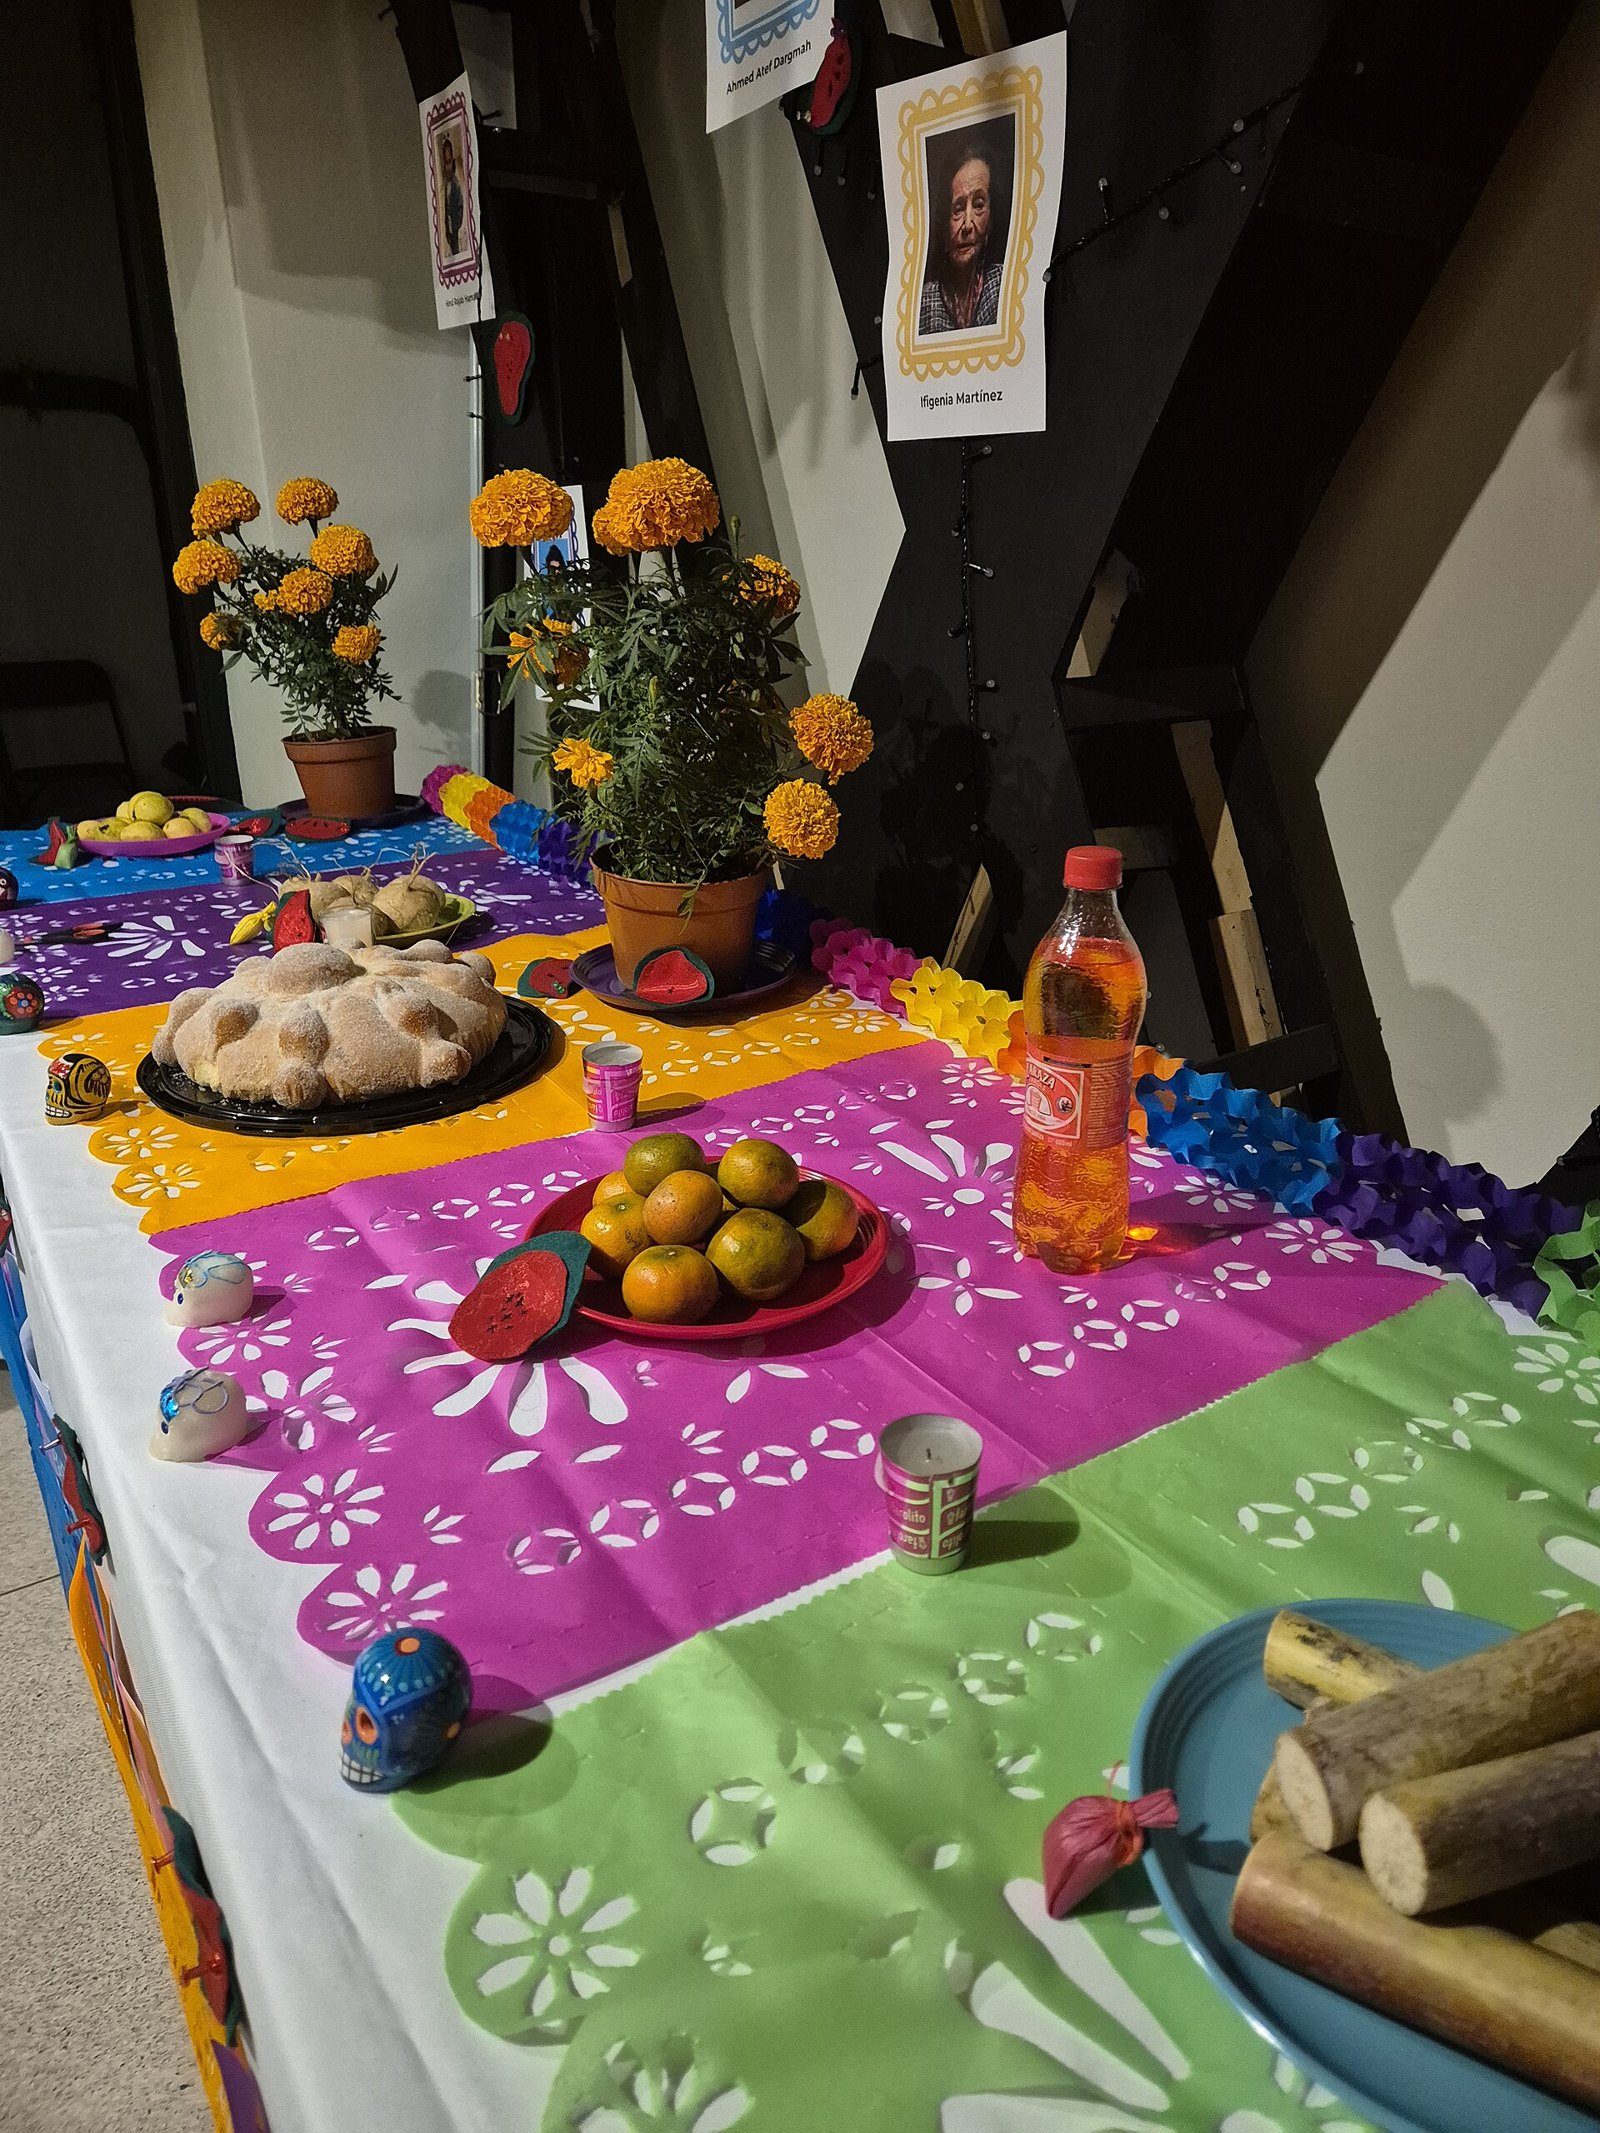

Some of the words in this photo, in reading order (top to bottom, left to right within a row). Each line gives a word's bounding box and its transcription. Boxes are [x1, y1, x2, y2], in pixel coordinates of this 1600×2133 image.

[726, 70, 754, 95] Ahmed
[756, 61, 772, 80] Atef
[773, 40, 811, 69] Dargmah
[920, 393, 953, 410] Ifigenia
[956, 389, 1003, 404] Martínez
